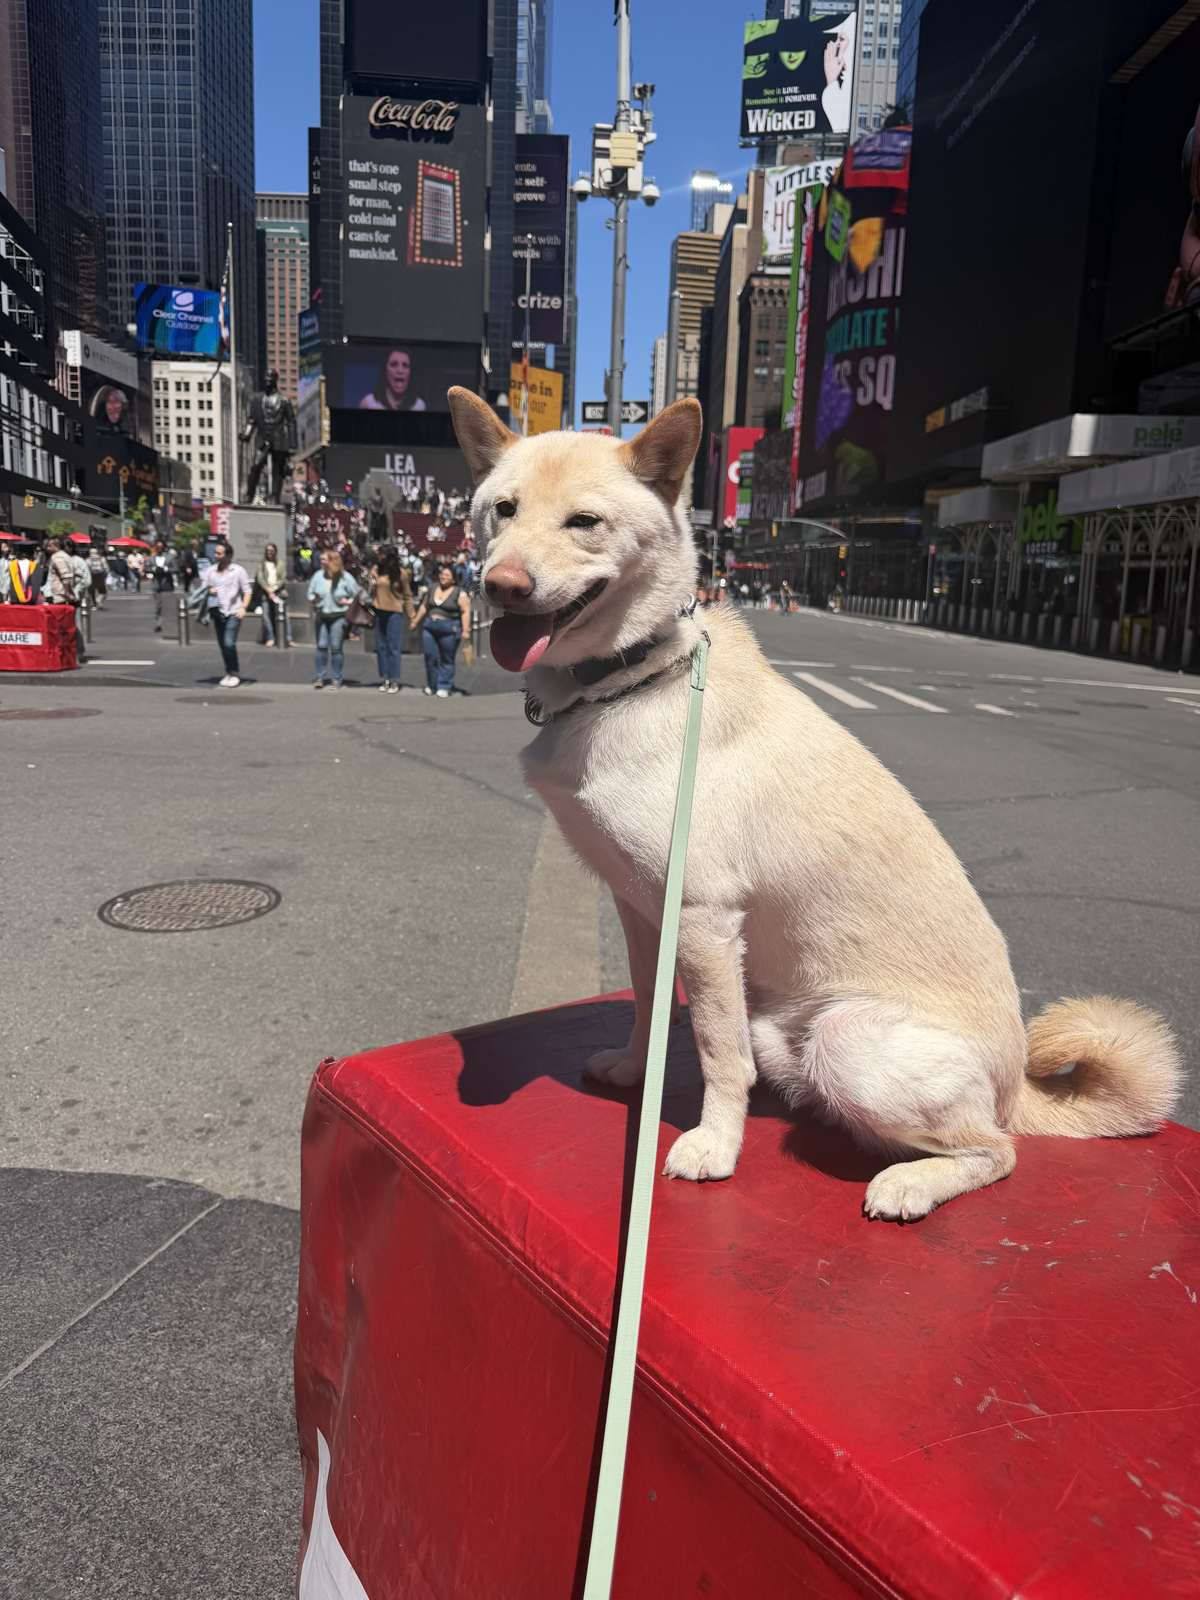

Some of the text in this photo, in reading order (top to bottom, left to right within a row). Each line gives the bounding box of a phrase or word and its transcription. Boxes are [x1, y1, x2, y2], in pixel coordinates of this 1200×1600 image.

[368, 96, 459, 131] Coca-Cola
[348, 159, 400, 175] that's one
[348, 178, 402, 195] small step
[775, 165, 821, 196] LITTLE
[348, 194, 365, 207] for
[348, 212, 372, 225] cold
[348, 230, 374, 242] cans
[152, 308, 214, 324] Clear Channel
[385, 453, 416, 474] LEA
